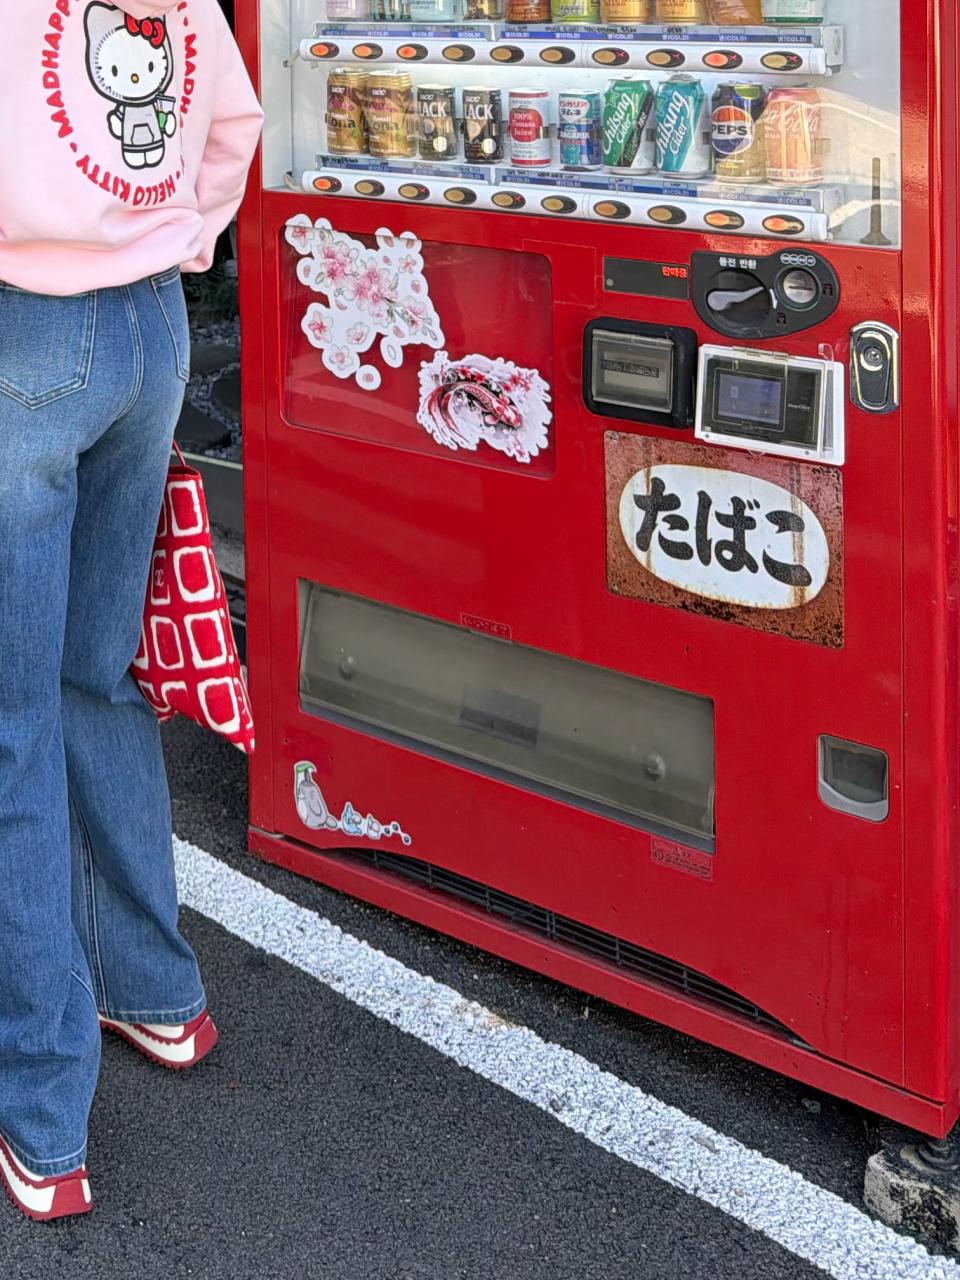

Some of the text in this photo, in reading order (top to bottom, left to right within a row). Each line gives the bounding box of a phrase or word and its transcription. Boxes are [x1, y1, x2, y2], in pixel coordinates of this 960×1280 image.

[420, 101, 447, 117] LACK
[464, 103, 494, 120] LACK
[603, 92, 634, 155] Chilsung
[616, 113, 632, 143] Cider
[669, 116, 688, 154] Cider
[712, 125, 748, 135] PEPS
[75, 154, 177, 206] HELLO KITTY
[719, 257, 736, 267] 동전
[633, 476, 813, 587] たばこ
